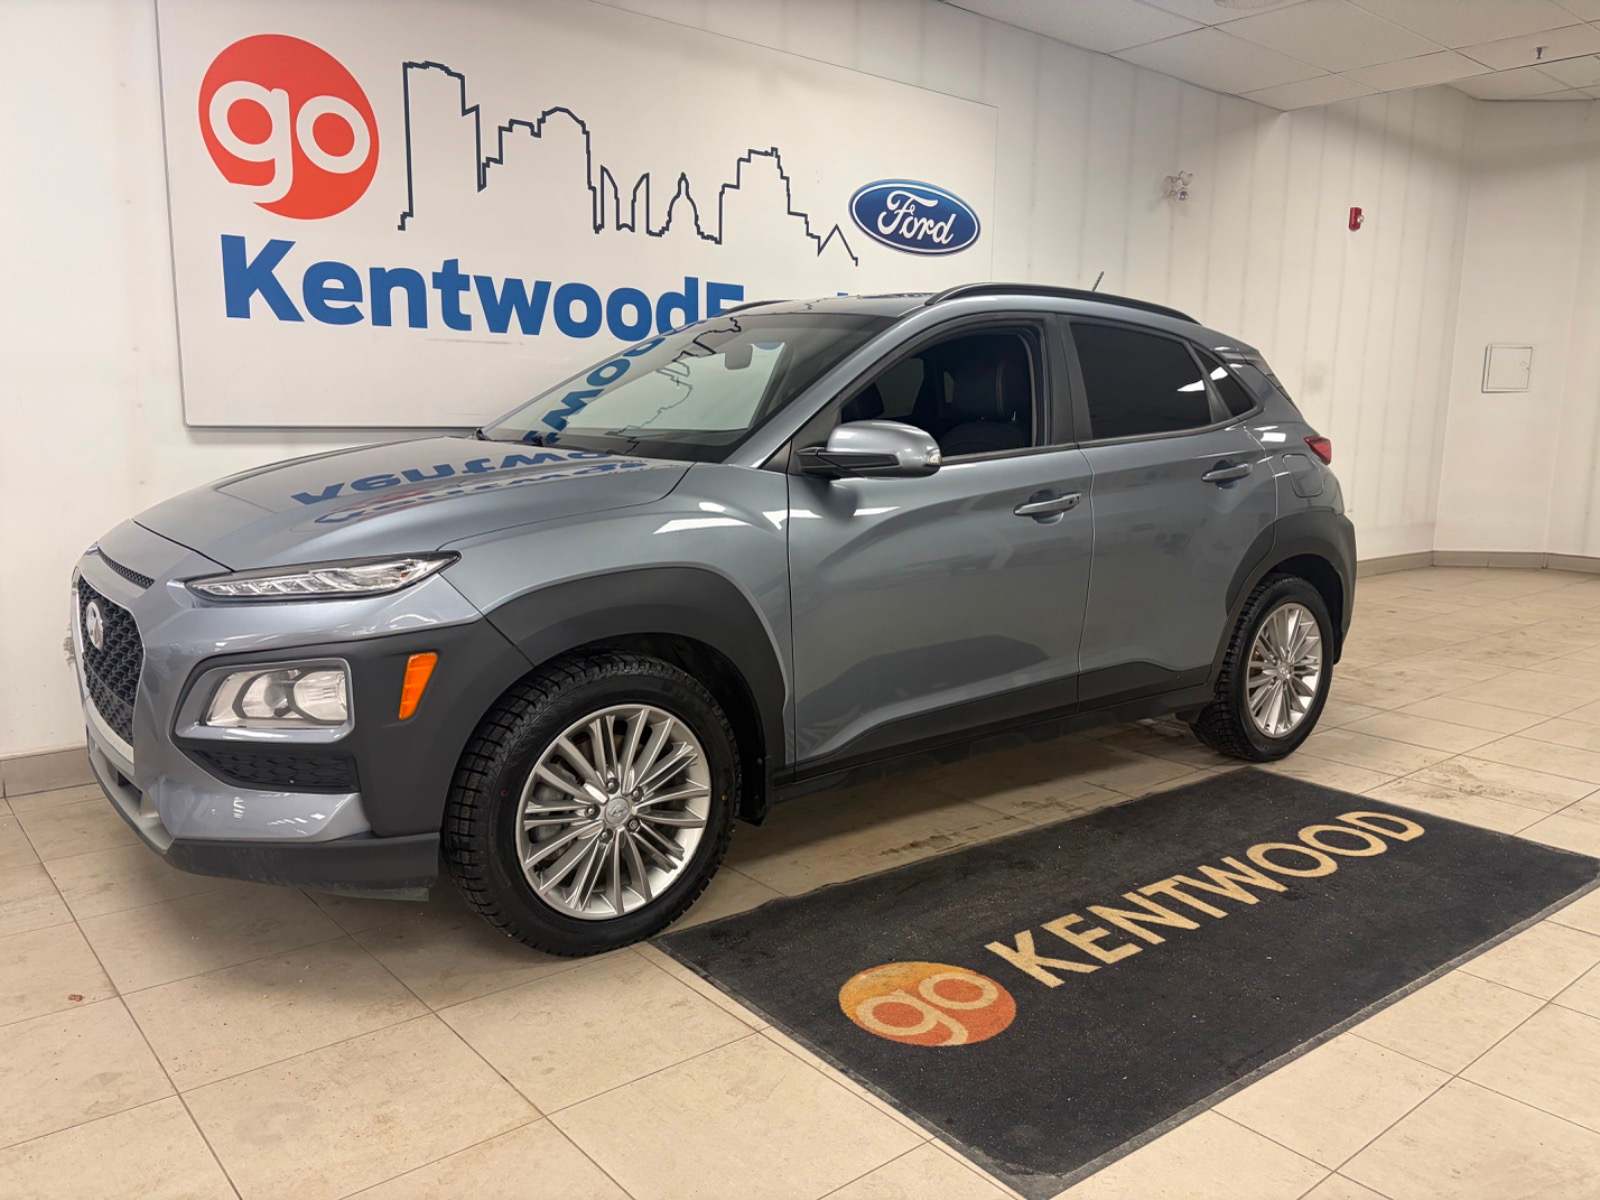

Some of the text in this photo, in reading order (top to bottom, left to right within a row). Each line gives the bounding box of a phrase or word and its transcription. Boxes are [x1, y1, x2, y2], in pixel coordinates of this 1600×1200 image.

[209, 80, 371, 203] go
[877, 189, 957, 245] Ford
[856, 810, 1426, 1046] go KENTWOOD
